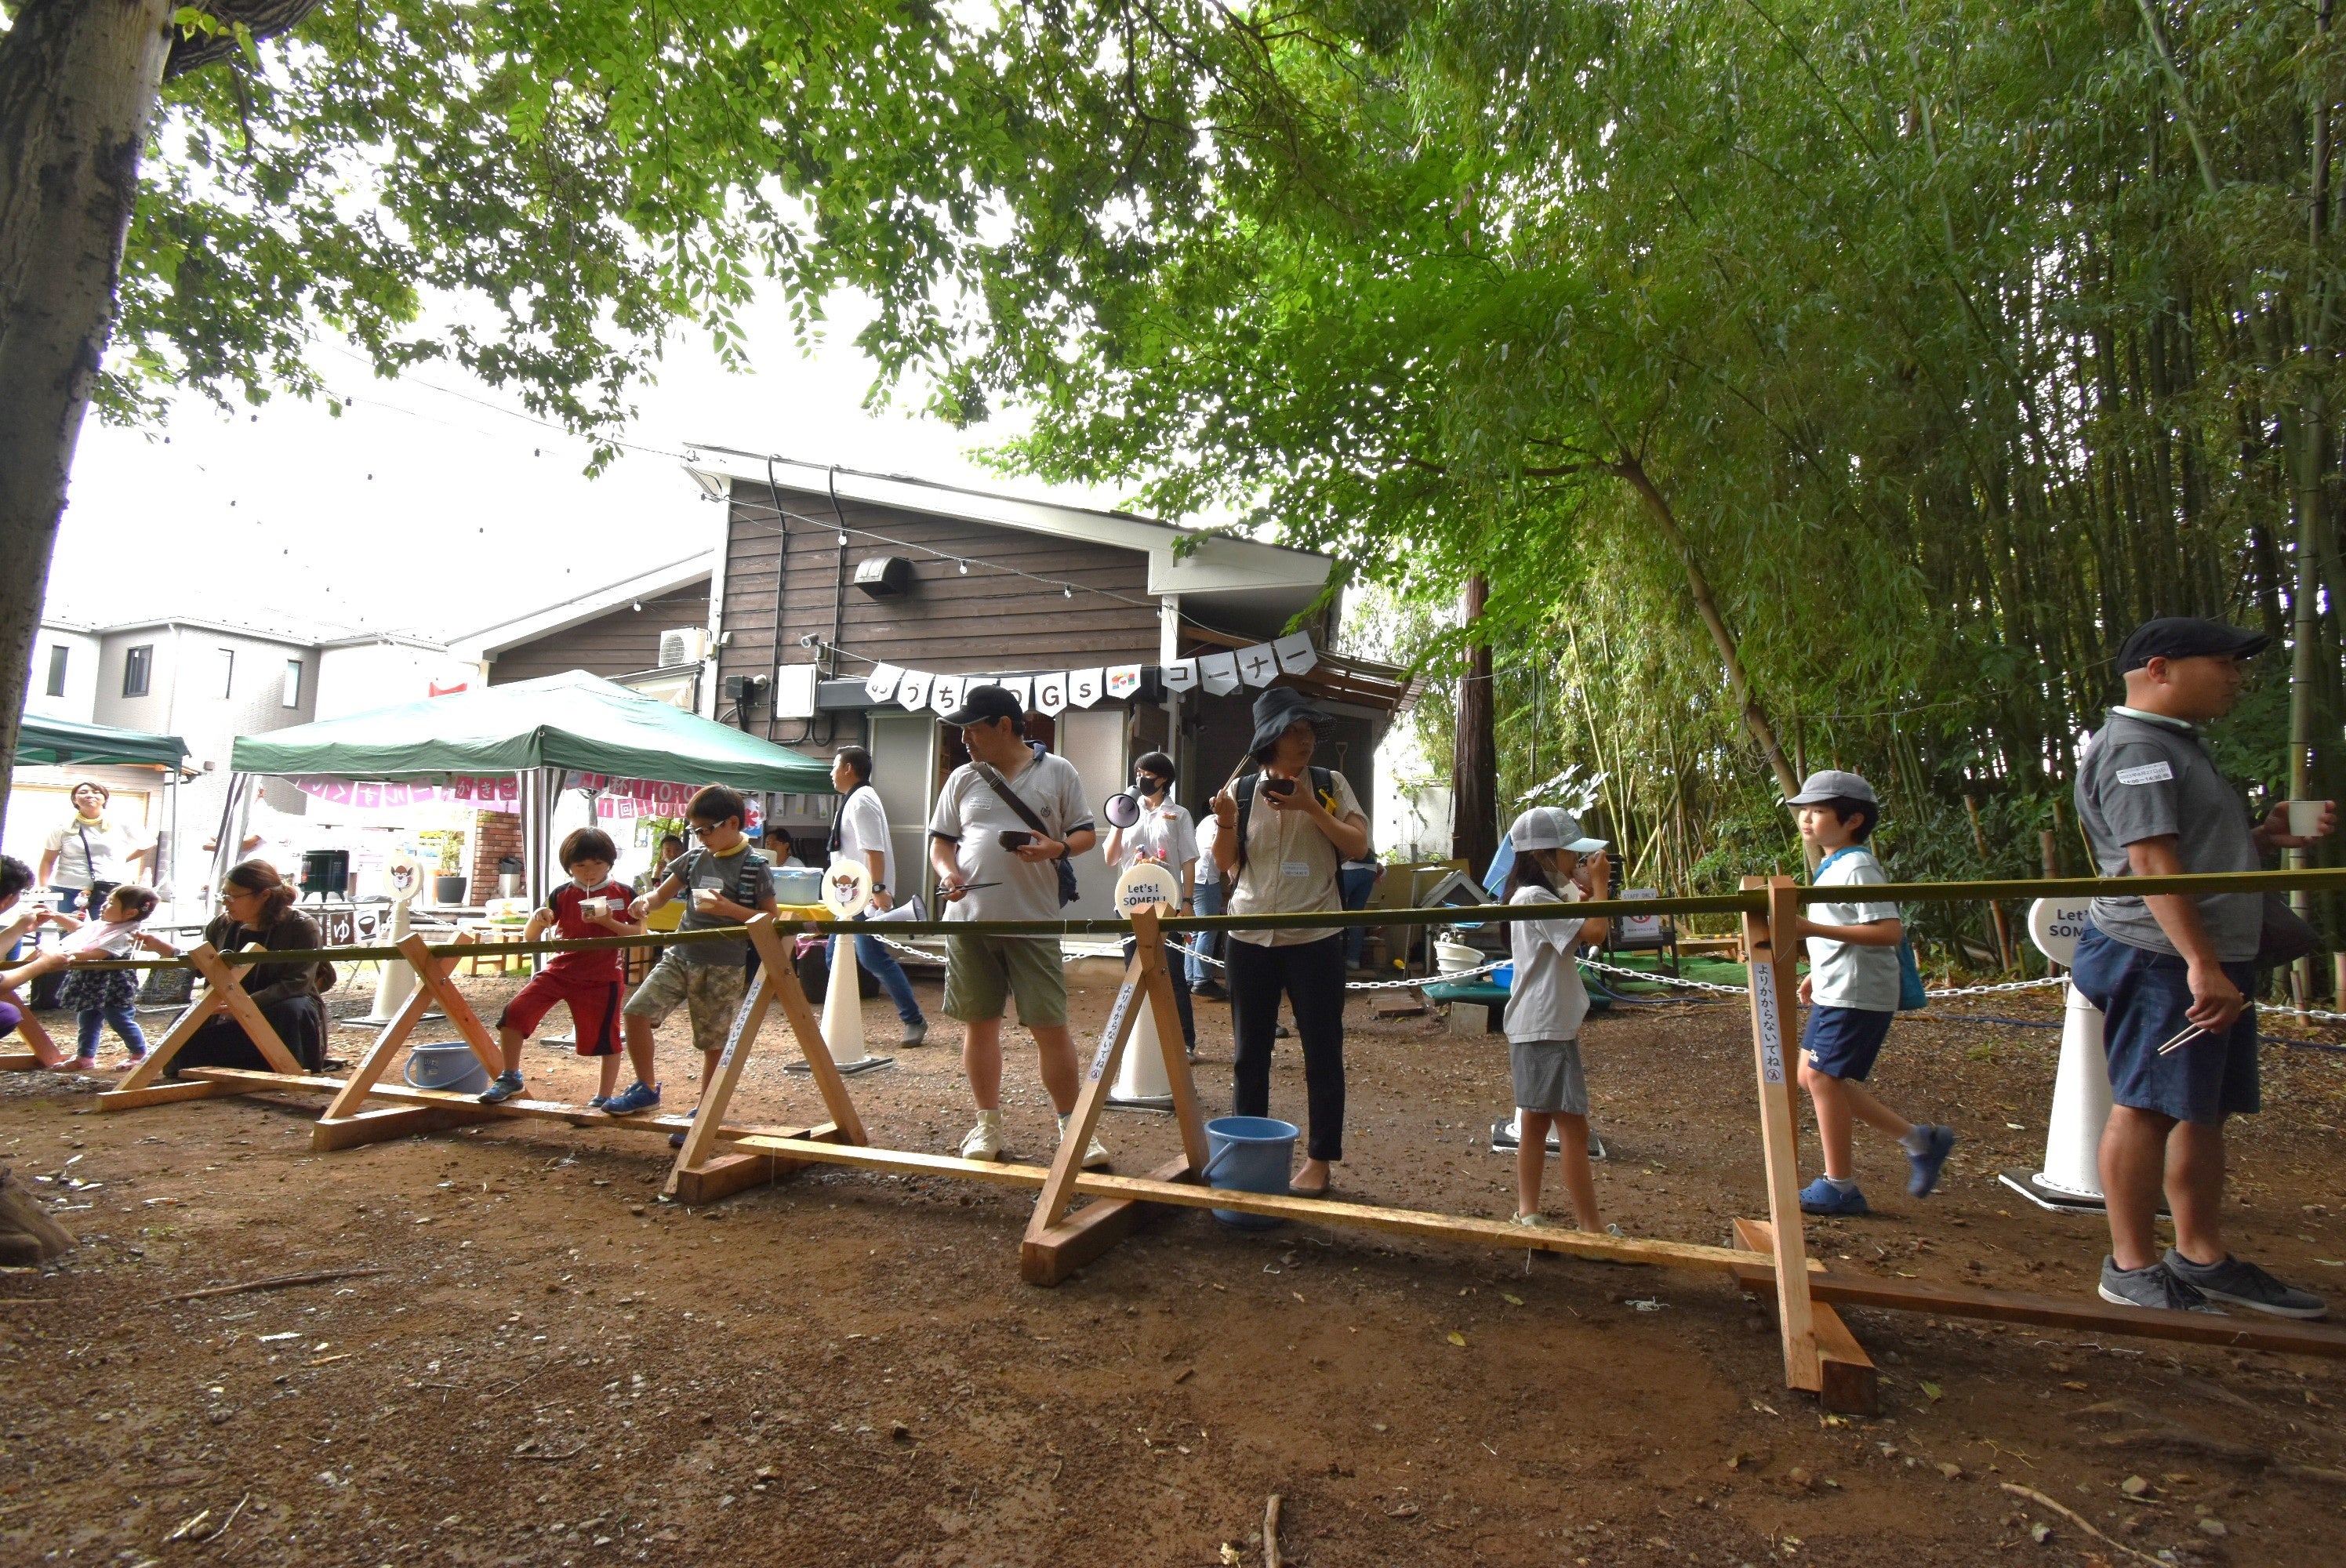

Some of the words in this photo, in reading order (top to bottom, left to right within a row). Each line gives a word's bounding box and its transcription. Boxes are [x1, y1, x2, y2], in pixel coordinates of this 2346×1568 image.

[1170, 649, 1307, 681] コーナー
[1095, 985, 1131, 1068] よりかからないでね
[1759, 965, 1781, 1067] よりかからないでね
